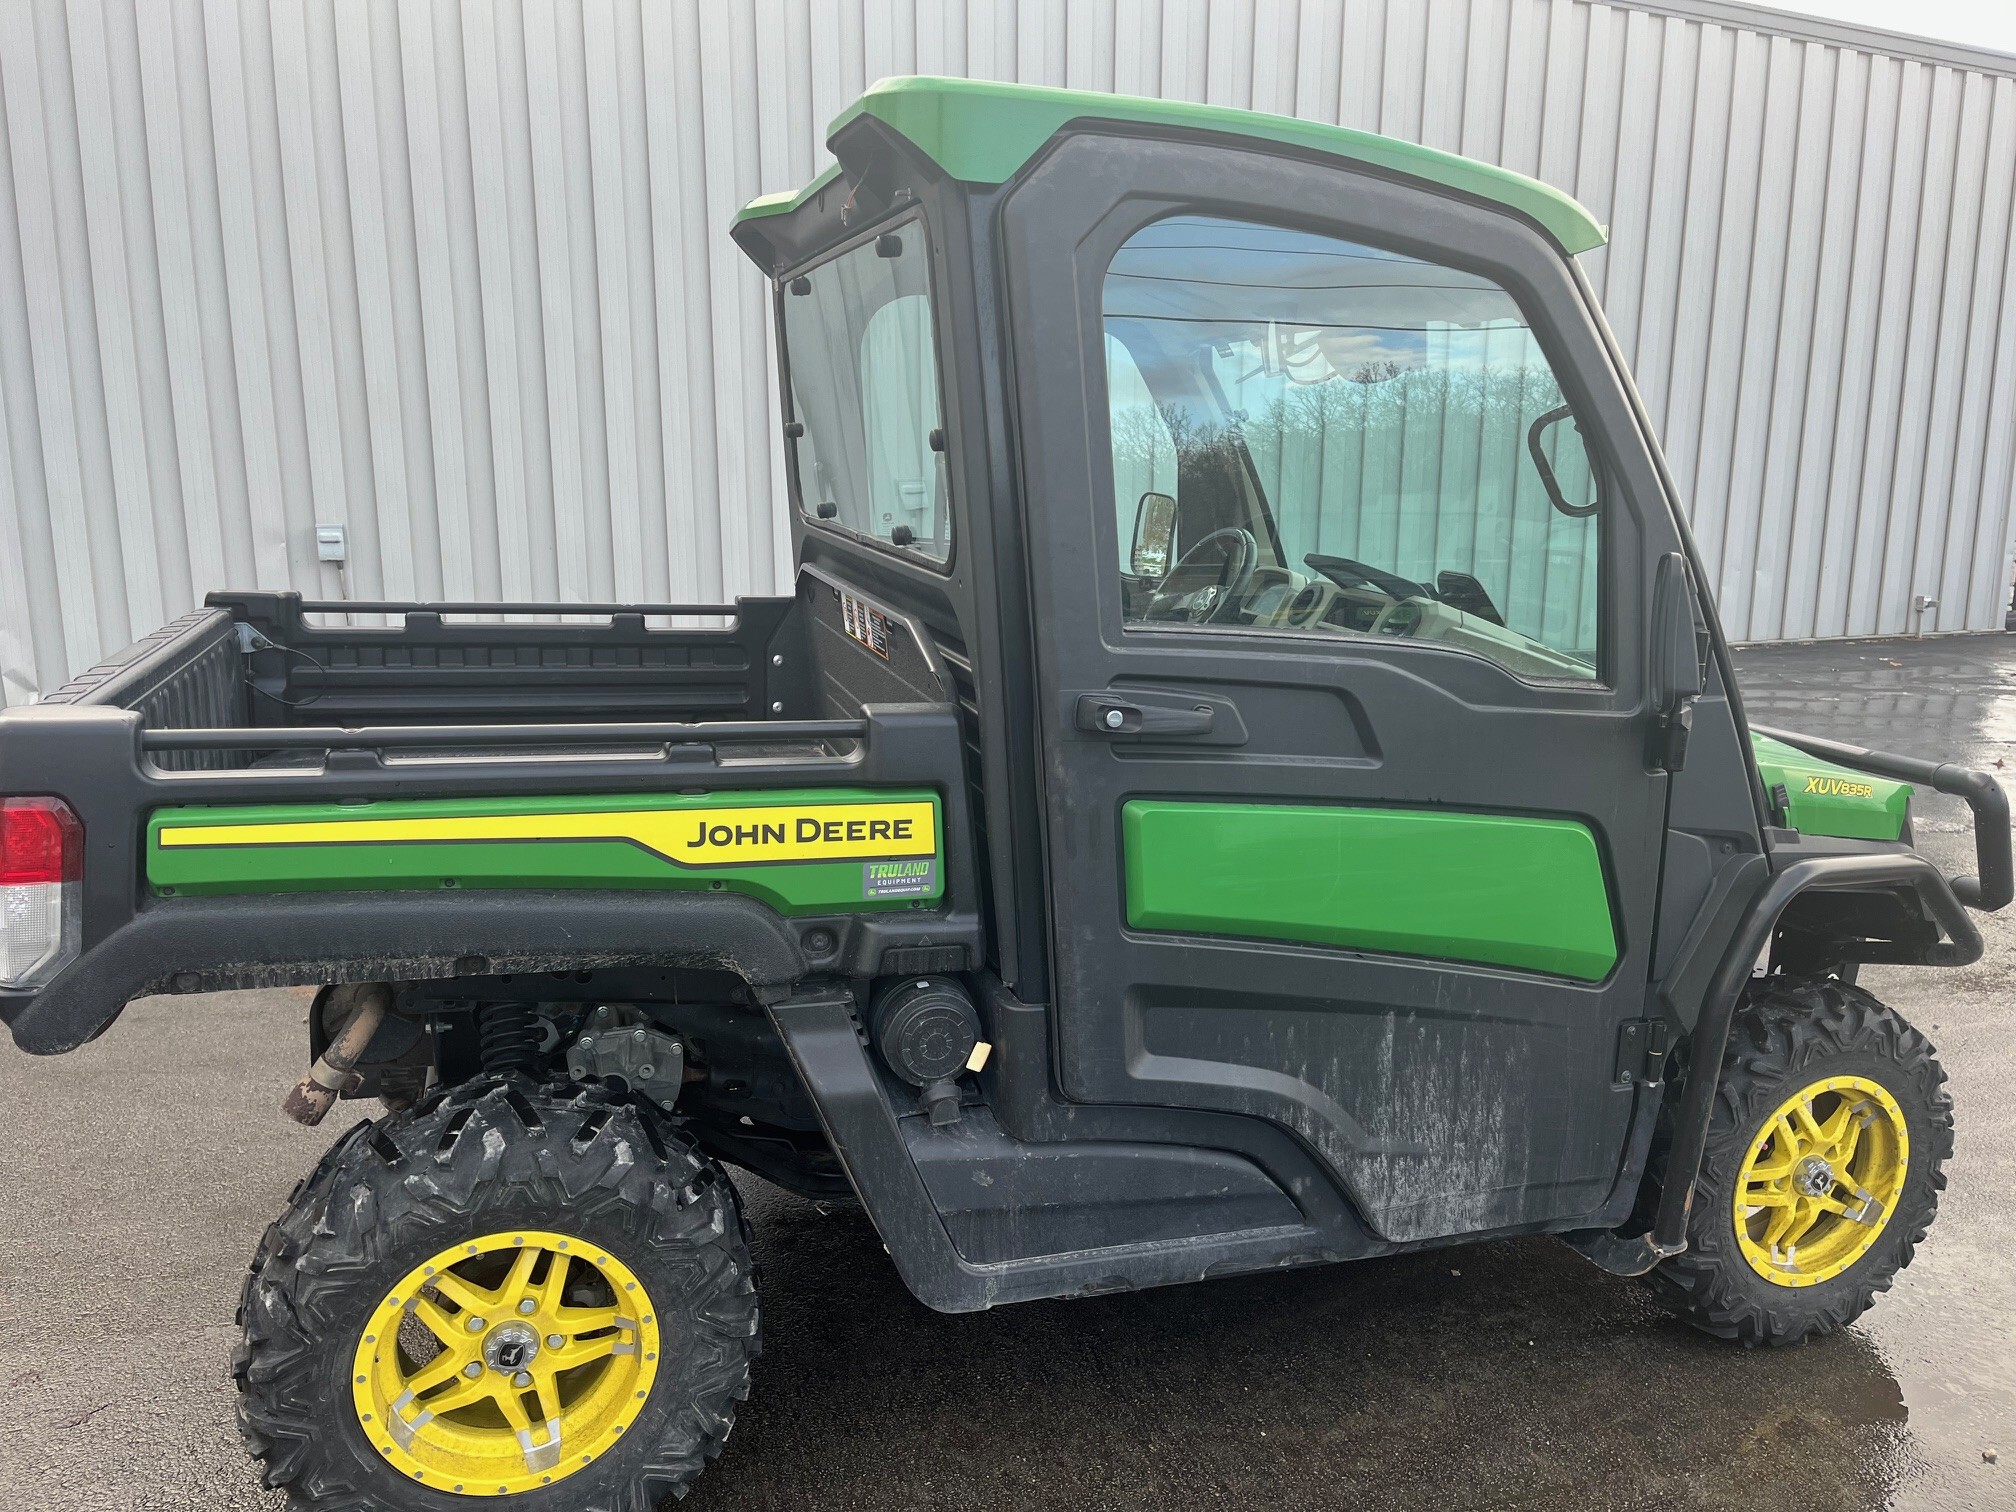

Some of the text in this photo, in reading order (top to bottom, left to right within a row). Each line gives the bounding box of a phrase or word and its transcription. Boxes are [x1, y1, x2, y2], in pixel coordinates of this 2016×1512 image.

[1803, 776, 1873, 797] XUV835R
[687, 818, 913, 848] JOHN DEERE
[869, 861, 930, 879] TRULAND
[877, 877, 922, 886] EQUIPMENT
